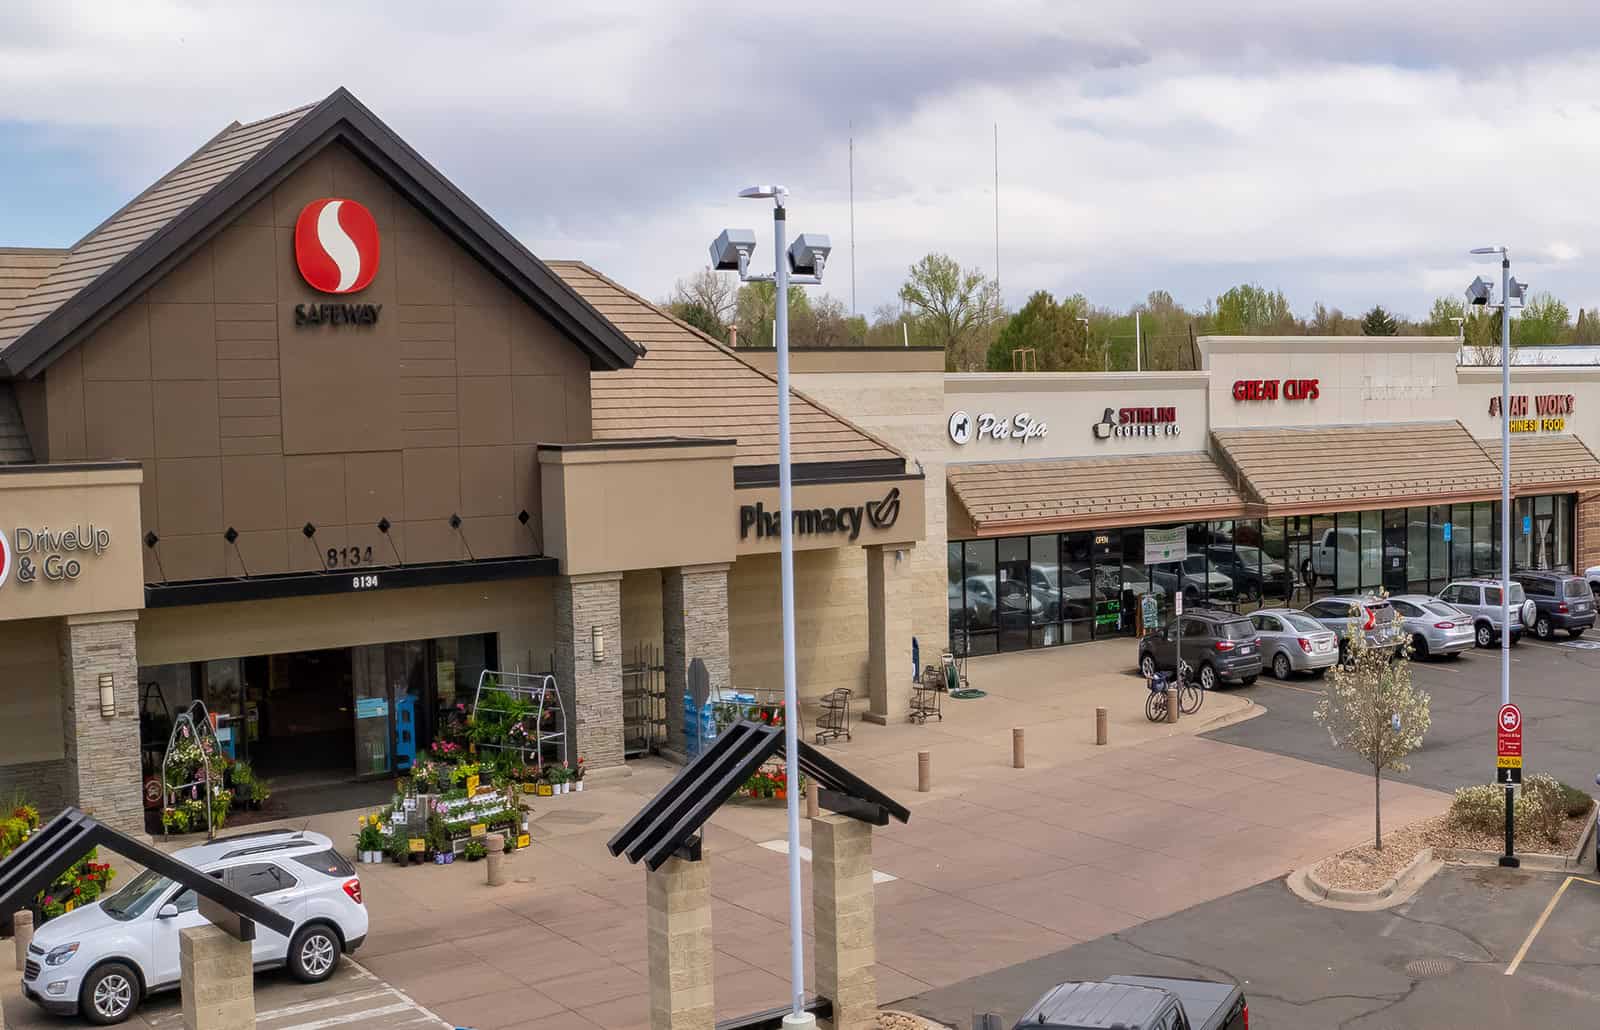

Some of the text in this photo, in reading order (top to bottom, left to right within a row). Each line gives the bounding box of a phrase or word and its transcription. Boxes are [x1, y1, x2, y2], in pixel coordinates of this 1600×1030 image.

[295, 302, 382, 326] SAFEWAY
[1233, 379, 1320, 401] GREAT CLIPS
[976, 412, 1048, 444] Pet Spa
[1115, 425, 1161, 437] COFFEE
[1509, 418, 1565, 433] HINESE FOOD
[740, 501, 864, 541] Pharmacy
[15, 523, 111, 556] DriveUp
[1095, 535, 1109, 544] OPEN
[327, 546, 373, 567] 8134
[18, 553, 81, 583] & Go
[352, 575, 378, 589] 8134
[1505, 769, 1513, 782] 1
